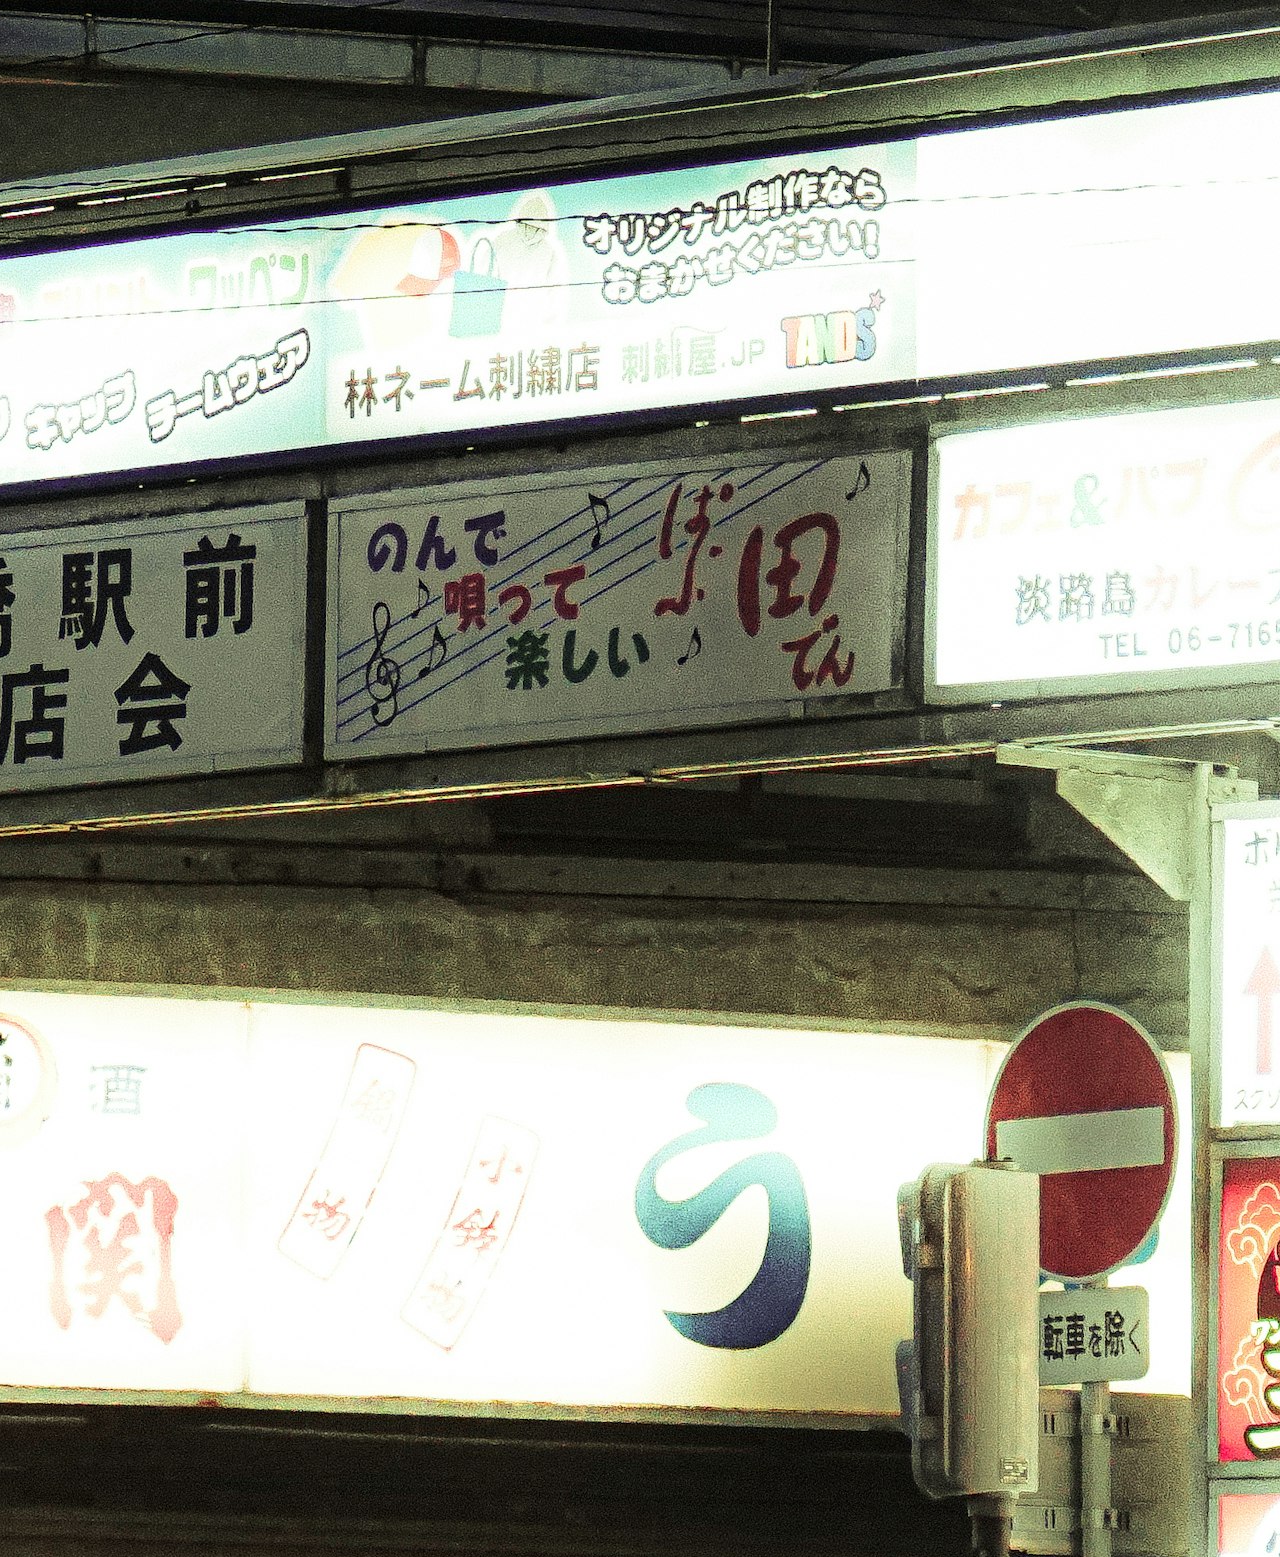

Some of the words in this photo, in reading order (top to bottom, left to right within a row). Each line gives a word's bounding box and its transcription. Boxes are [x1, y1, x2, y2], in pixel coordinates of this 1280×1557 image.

[583, 166, 886, 255] オリジナル制作なら
[781, 307, 877, 368] TANDS
[145, 327, 311, 443] チームウェア
[344, 342, 600, 419] 林ネーム刺繍店
[367, 508, 507, 574] のんで
[442, 562, 585, 633] 唄って
[505, 626, 650, 692] 楽しい
[1098, 631, 1148, 660] TEL
[633, 1082, 813, 1352] う
